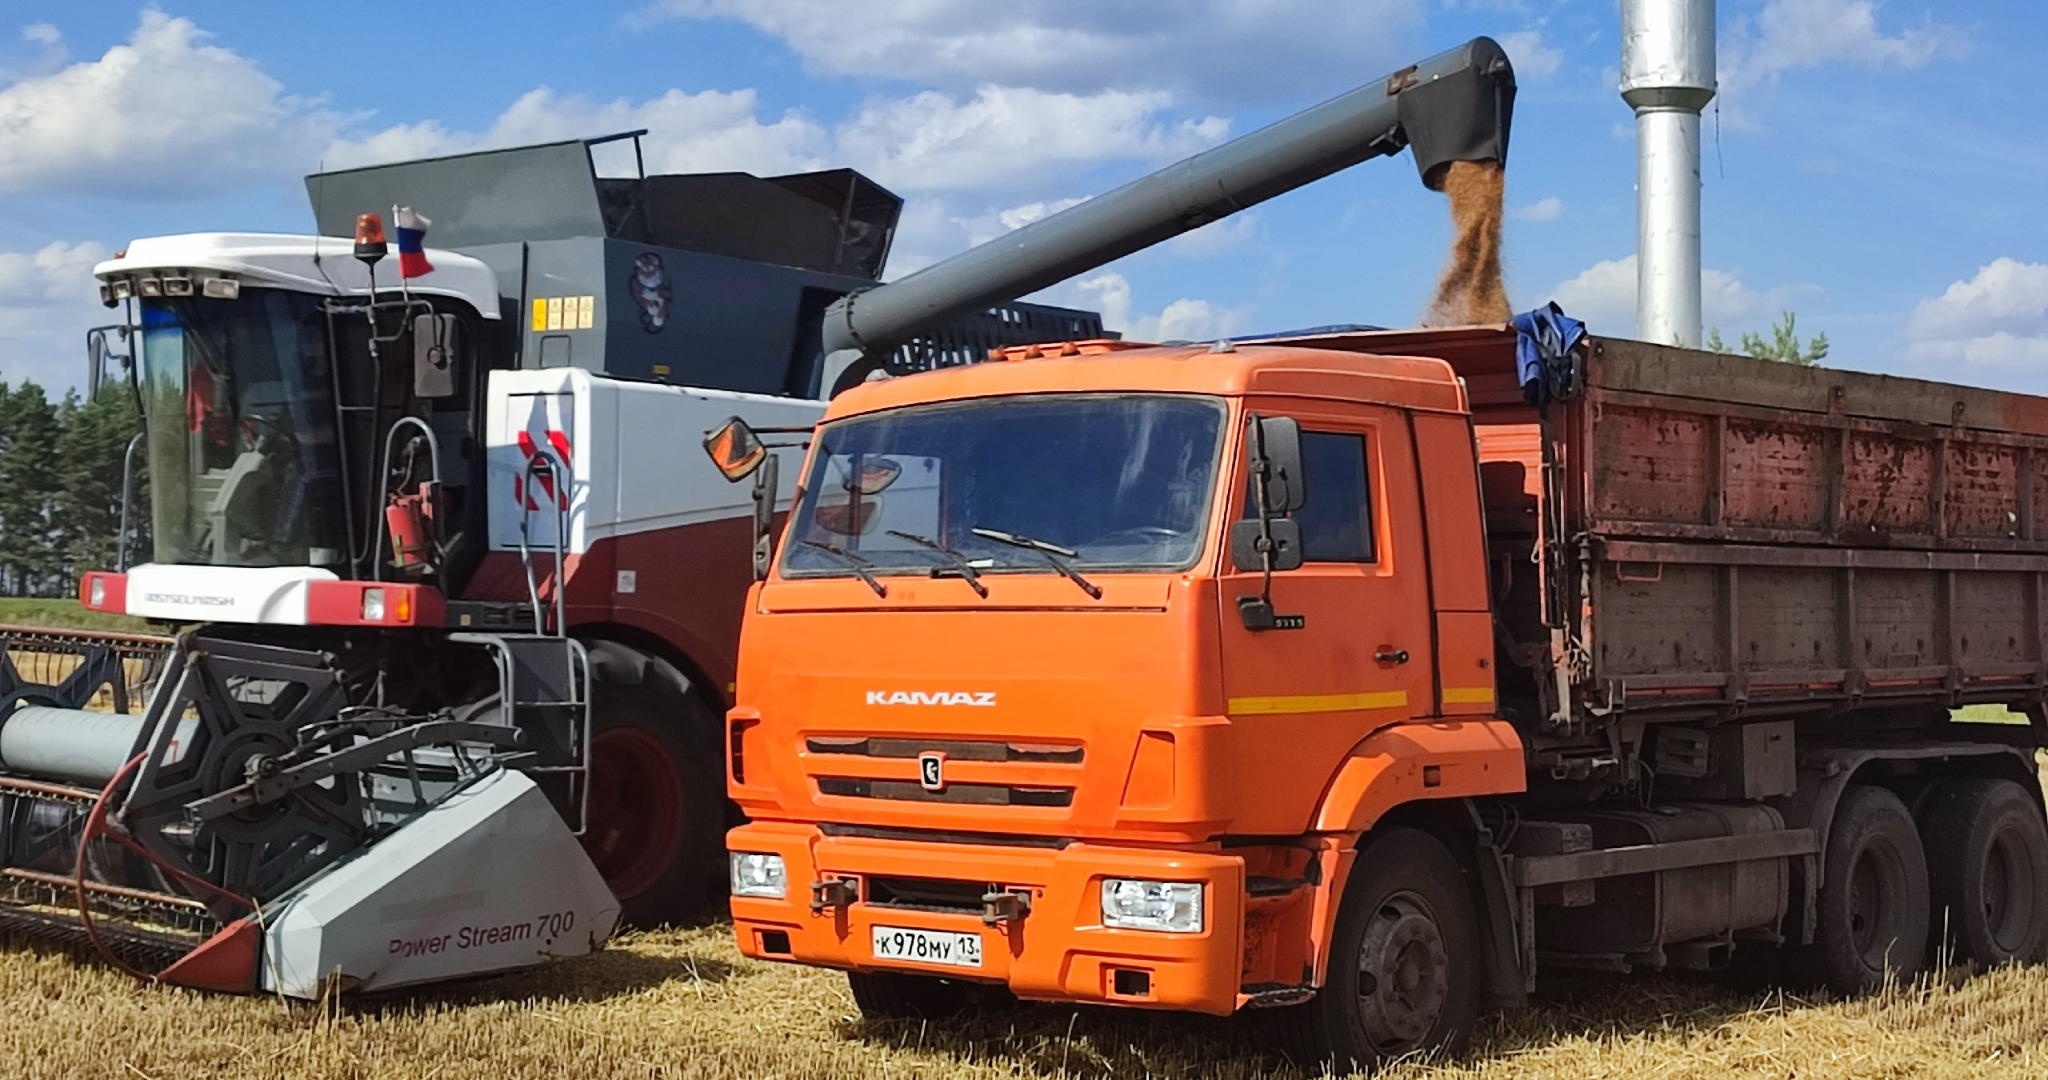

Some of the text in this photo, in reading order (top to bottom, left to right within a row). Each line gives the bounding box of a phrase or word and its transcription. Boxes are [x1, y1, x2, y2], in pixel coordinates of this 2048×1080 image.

[866, 691, 996, 706] KAMAZ
[389, 911, 575, 958] Power Stream 700
